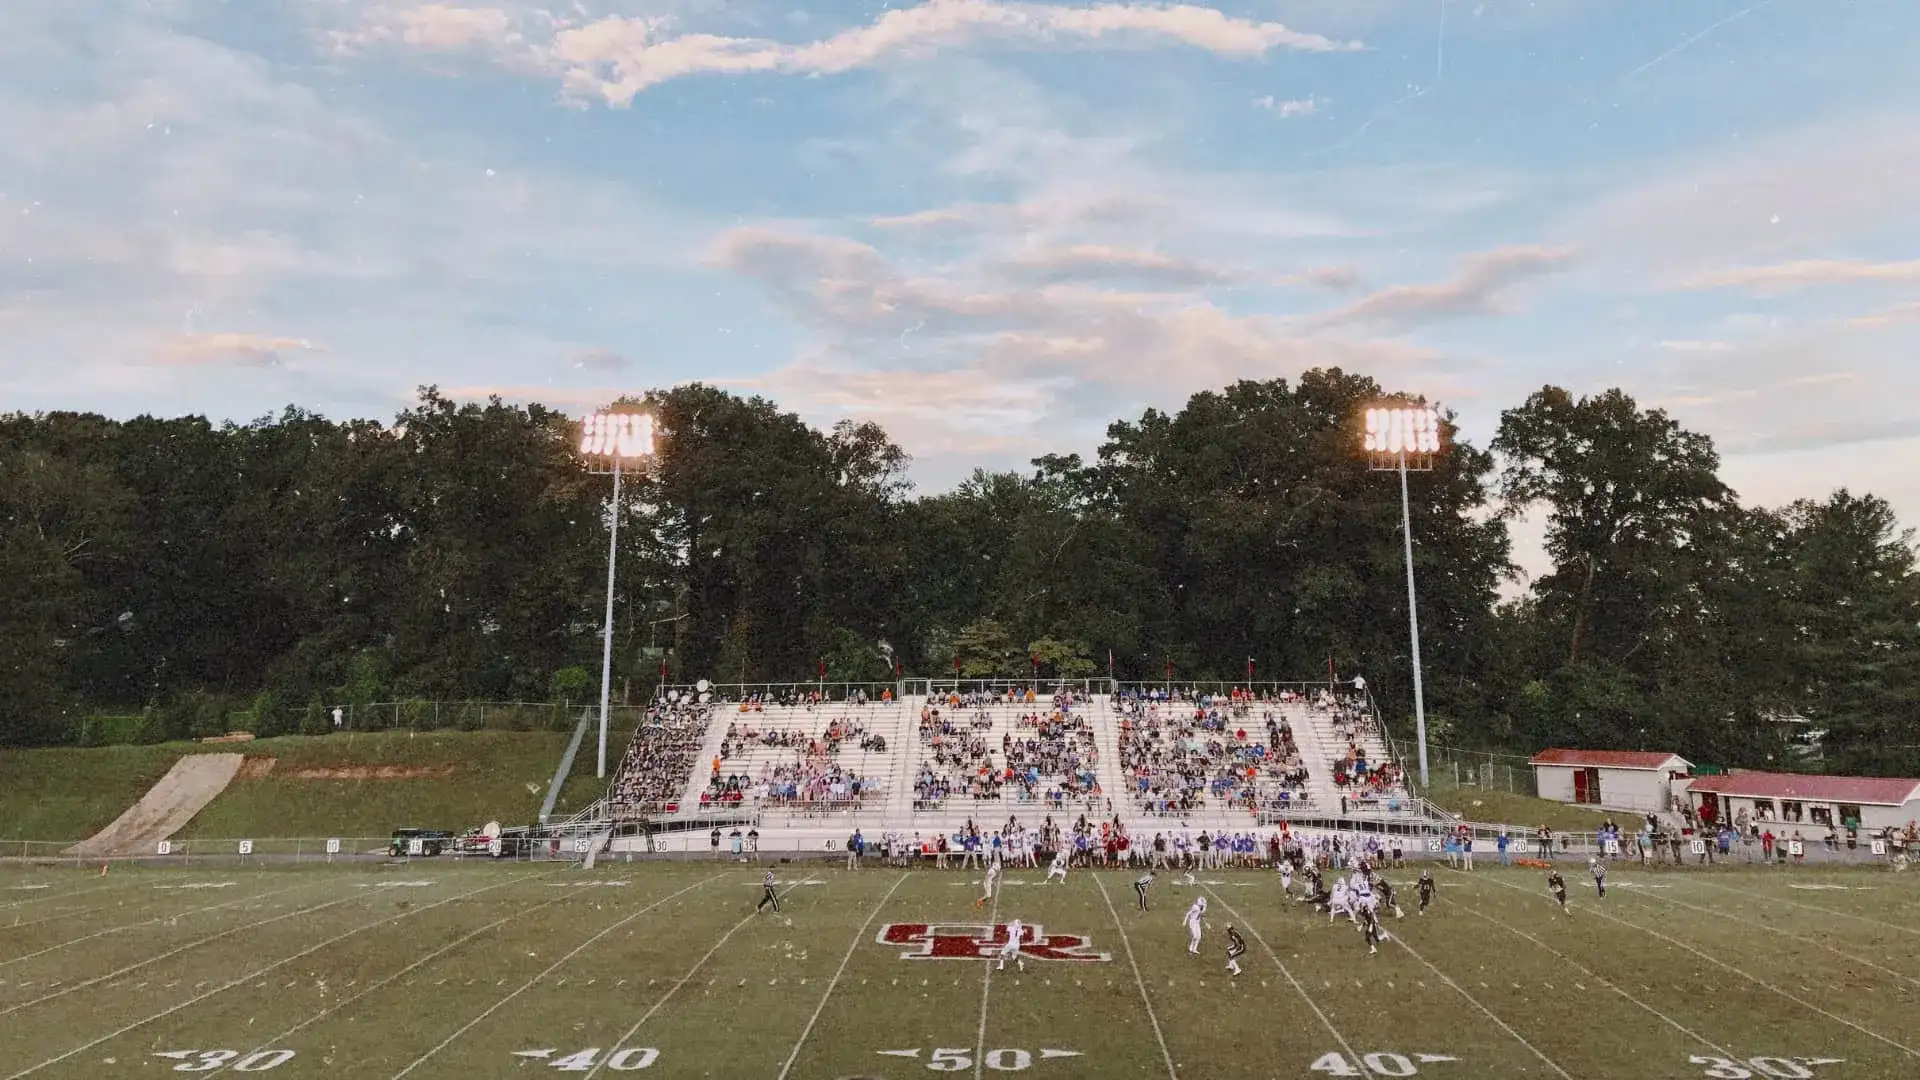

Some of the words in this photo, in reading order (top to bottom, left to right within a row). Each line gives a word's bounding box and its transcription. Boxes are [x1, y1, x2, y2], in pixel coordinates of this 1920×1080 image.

[328, 841, 338, 852] 10
[411, 841, 421, 851] 15
[490, 840, 501, 850] 20
[576, 840, 587, 850] 25
[657, 840, 667, 851] 30
[744, 840, 754, 851] 35
[825, 840, 836, 851] 40
[1430, 840, 1440, 851] 25
[1515, 840, 1526, 851] 20
[1607, 841, 1618, 852] 15
[1693, 841, 1704, 852] 10
[173, 1049, 296, 1072] 30
[547, 1047, 660, 1071] 40
[924, 1047, 1032, 1071] 50
[1310, 1052, 1417, 1076] 40
[1689, 1054, 1814, 1079] 30
